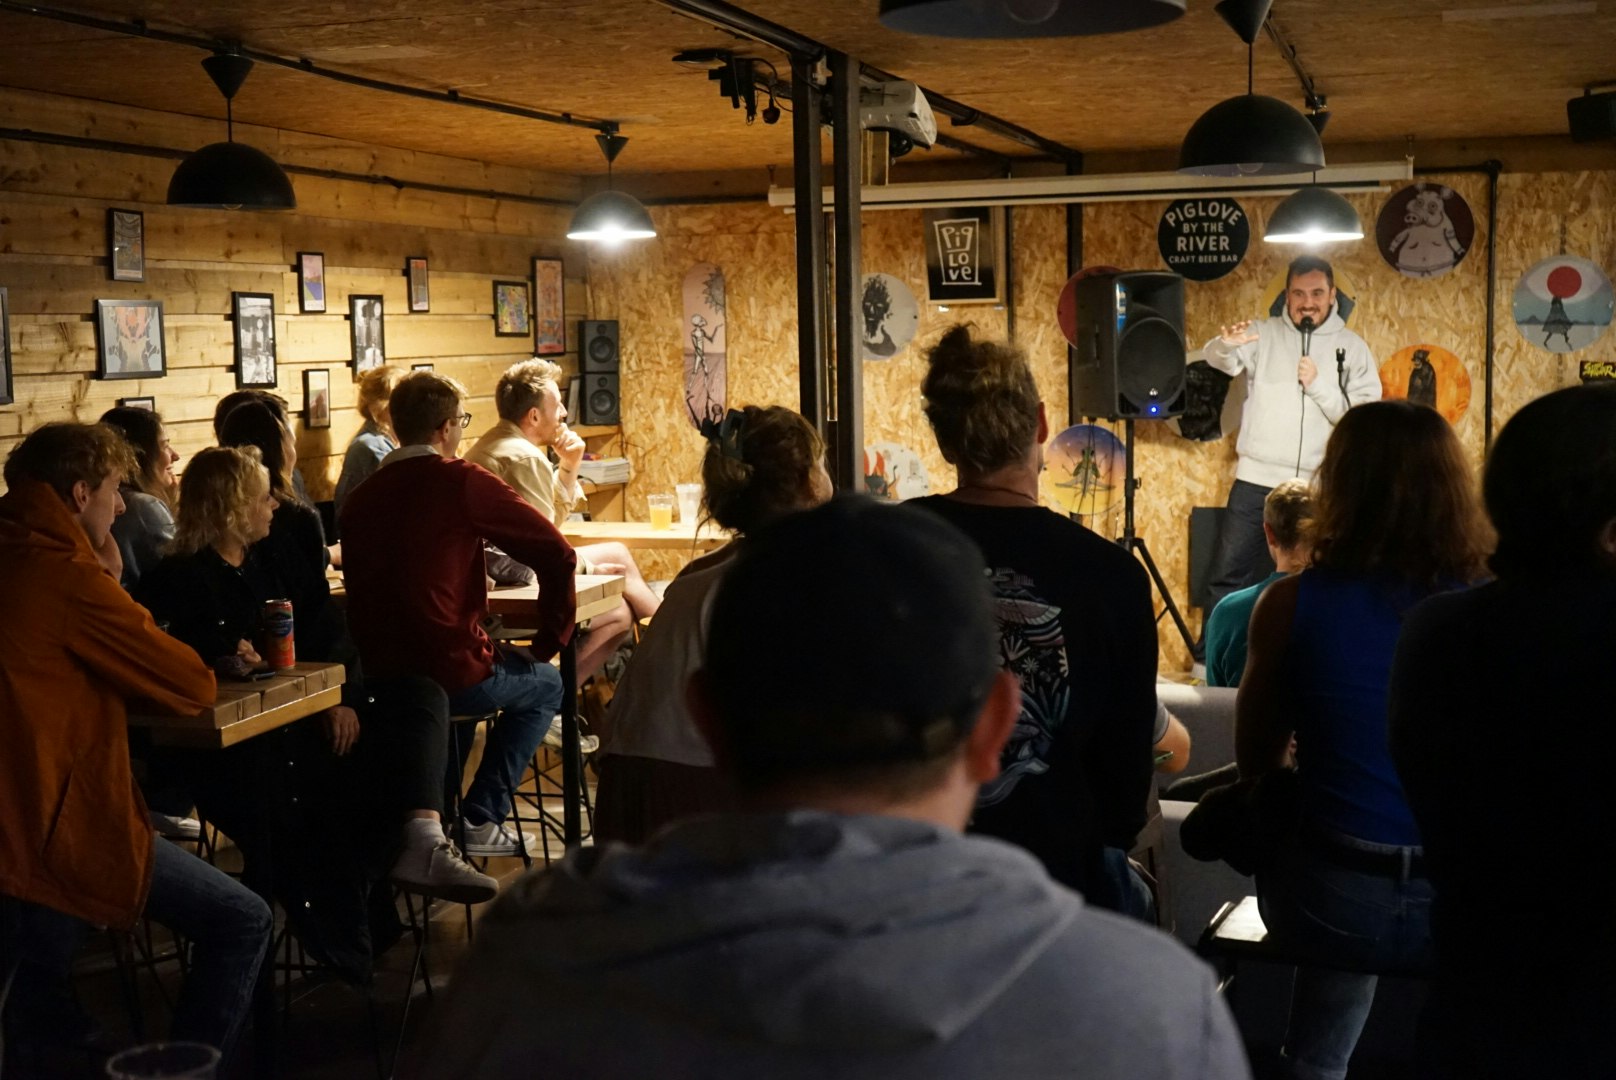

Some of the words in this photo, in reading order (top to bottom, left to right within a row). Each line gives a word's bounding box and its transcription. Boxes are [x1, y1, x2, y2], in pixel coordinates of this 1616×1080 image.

[1165, 201, 1242, 227] PIGLOVE
[1183, 222, 1198, 234] BY
[1202, 222, 1224, 233] THE
[941, 226, 974, 253] Pig
[1177, 236, 1230, 252] RIVER
[1169, 255, 1196, 264] CRAFT
[1198, 255, 1218, 263] BEER
[1221, 254, 1238, 263] BAR
